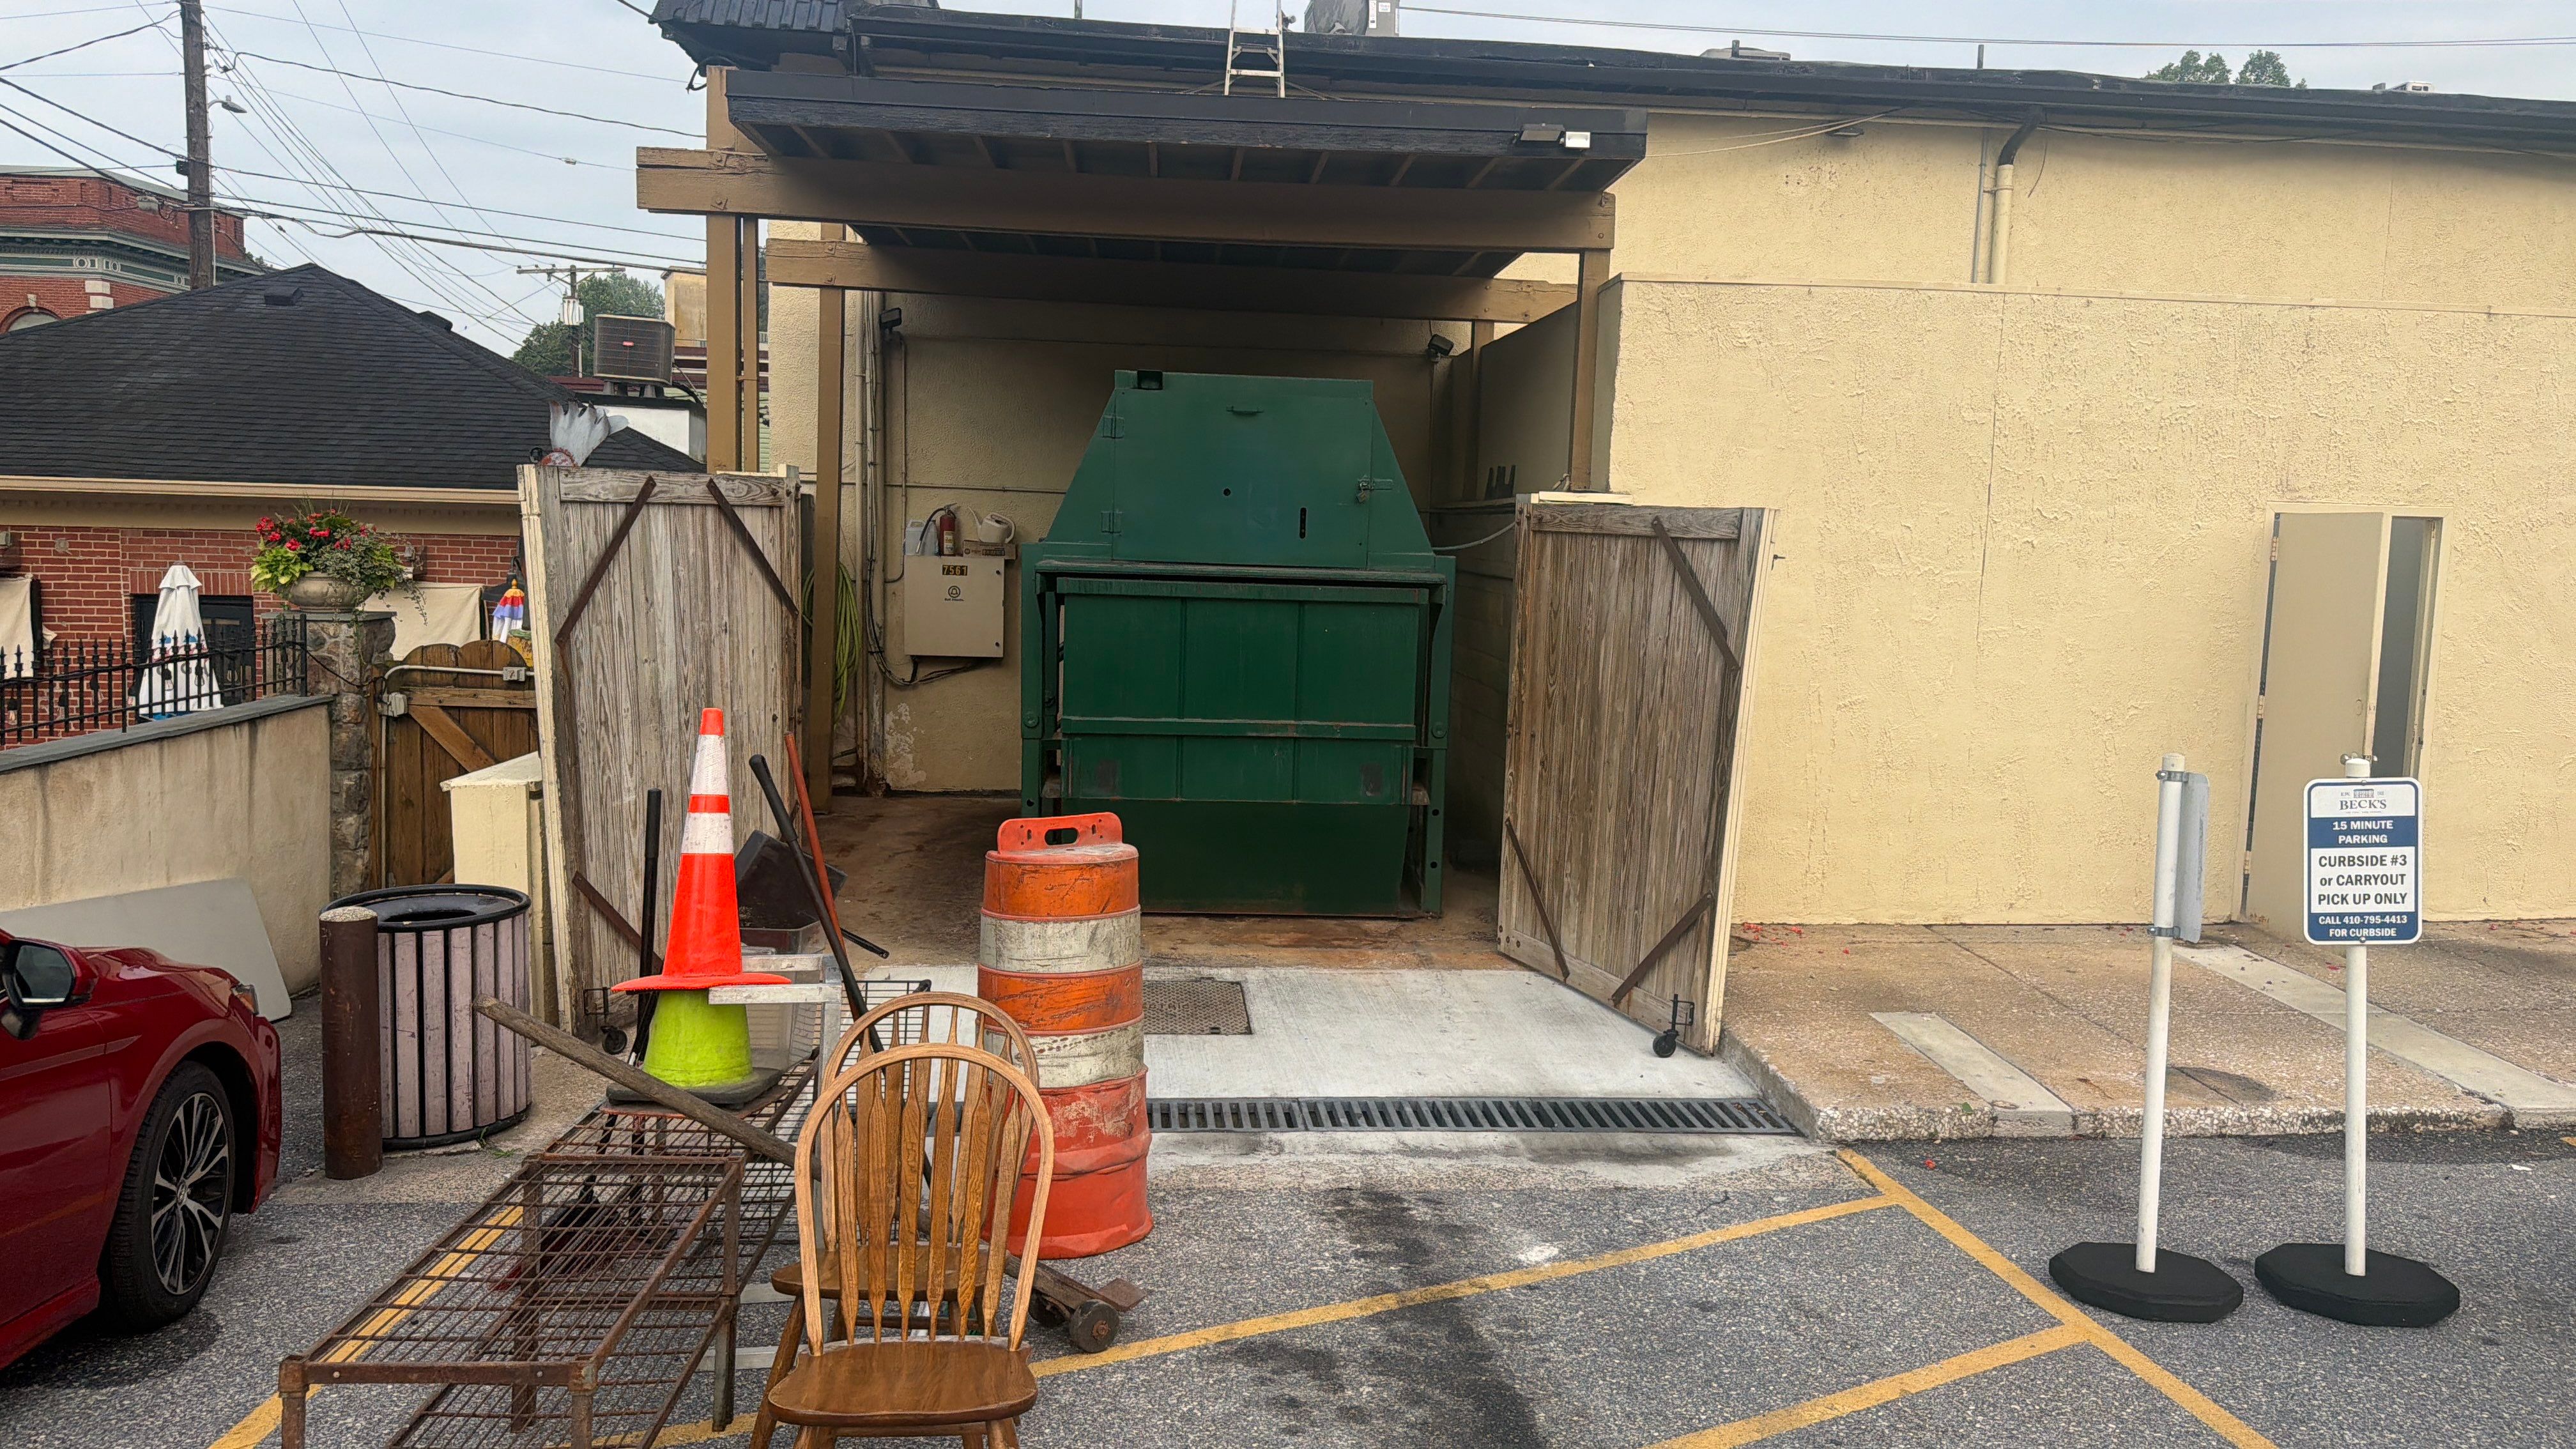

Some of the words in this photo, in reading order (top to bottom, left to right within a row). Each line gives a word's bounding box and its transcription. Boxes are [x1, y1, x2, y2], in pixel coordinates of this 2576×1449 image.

[943, 565, 967, 575] 7561
[2333, 822, 2347, 830] 15
[2350, 820, 2393, 829] MINUTE
[2339, 834, 2388, 843] PARKING
[2319, 855, 2387, 867] CURBSIDE
[2390, 855, 2407, 866] #3
[2320, 878, 2333, 886] or
[2336, 874, 2406, 885] CARRYOUT
[2319, 894, 2349, 905] PICK
[2353, 894, 2370, 905] UP
[2375, 893, 2407, 904] ONLY
[2343, 915, 2407, 924] 410-795-4413
[2350, 928, 2396, 937] CURBSIDE
